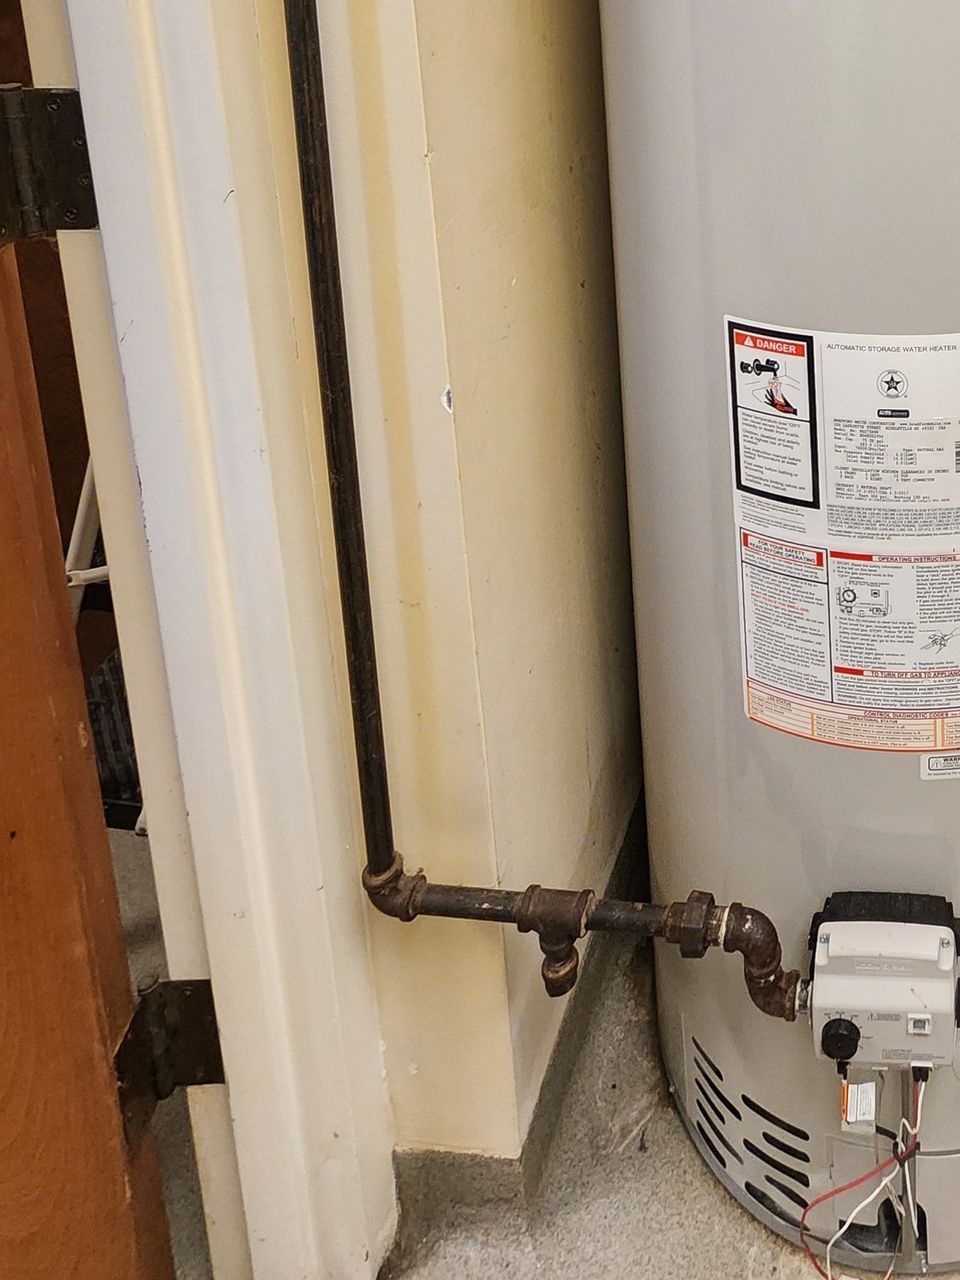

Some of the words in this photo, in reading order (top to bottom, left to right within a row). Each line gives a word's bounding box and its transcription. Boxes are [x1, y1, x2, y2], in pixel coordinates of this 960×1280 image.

[756, 339, 798, 354] DANGER
[827, 344, 866, 352] AUTOMATIC
[749, 541, 762, 550] READ
[763, 546, 783, 556] BEFORE
[784, 553, 816, 564] OPERATING
[784, 548, 805, 557] SAFETY
